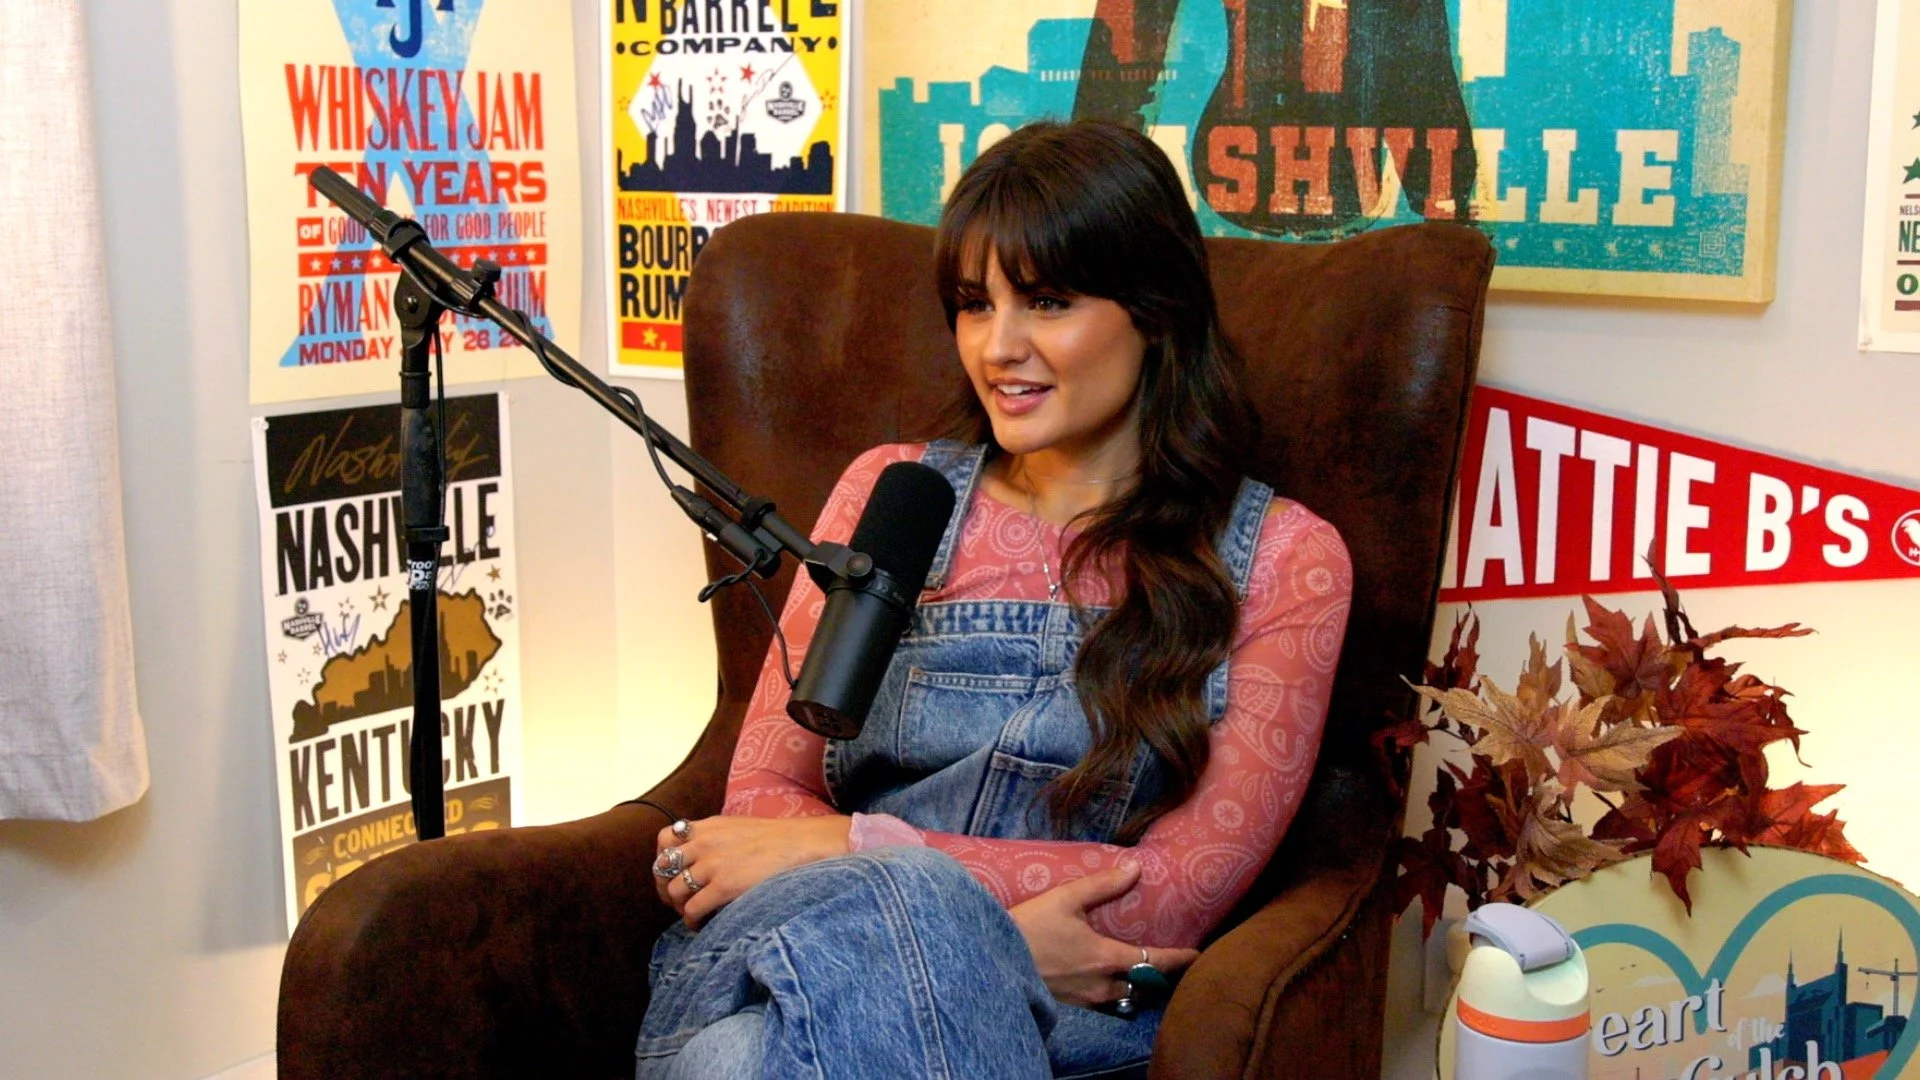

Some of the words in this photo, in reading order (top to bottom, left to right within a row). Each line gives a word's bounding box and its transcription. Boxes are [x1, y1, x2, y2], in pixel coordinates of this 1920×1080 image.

[660, 0, 799, 35] BARREL
[630, 36, 822, 56] COMPANY
[284, 63, 463, 152] WHISKEY
[466, 70, 545, 151] JAM
[295, 161, 387, 208] TN
[402, 161, 548, 207] YEARS
[1147, 124, 1679, 227] SHVILLE
[300, 224, 321, 240] OF
[424, 213, 449, 241] FOR
[456, 211, 491, 240] GOOD
[498, 211, 546, 239] PEOPLE
[617, 198, 697, 222] NASHVILLE'S
[706, 199, 757, 222] NEWEST
[299, 278, 391, 338] RYMAN
[300, 336, 394, 367] MONDAY
[464, 329, 490, 352] 26
[1745, 471, 1870, 573] B'S
[333, 798, 464, 859] CONNECD
[1592, 977, 1727, 1057] eart
